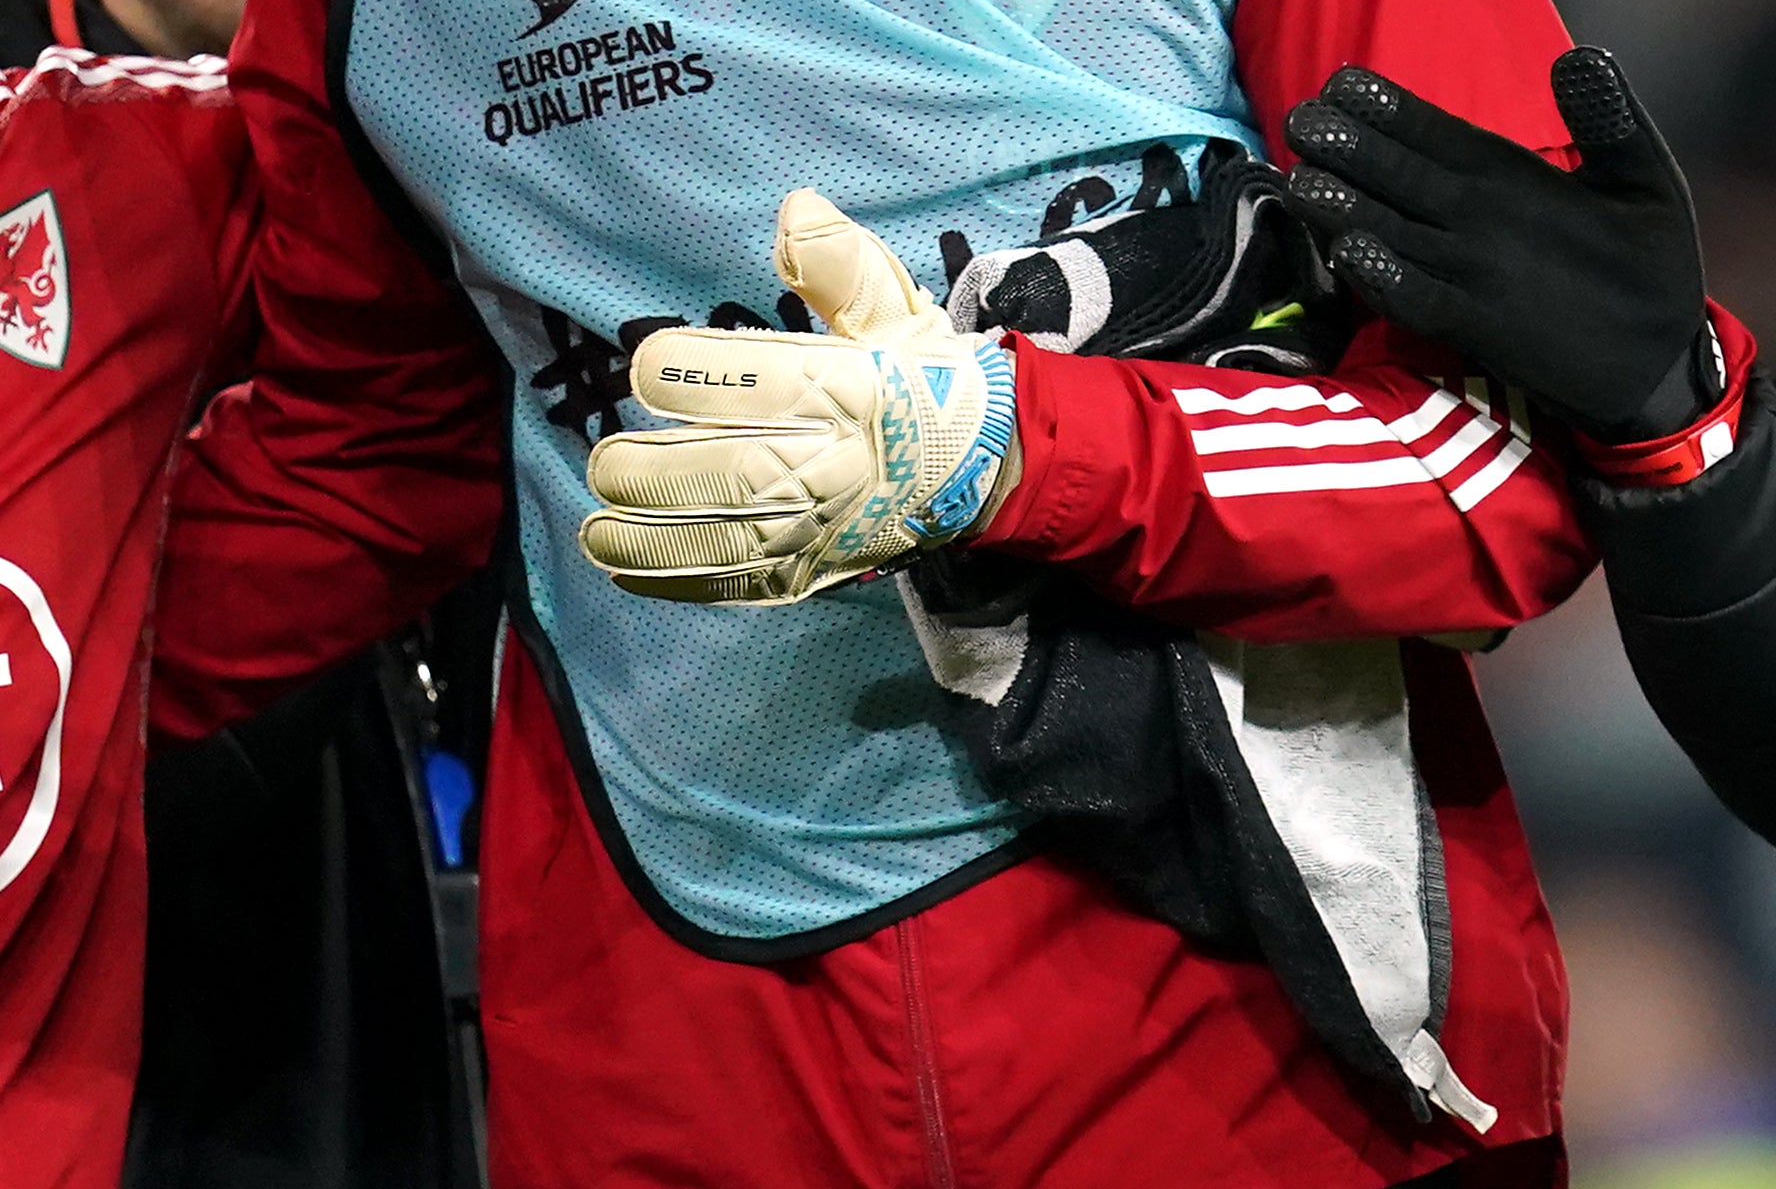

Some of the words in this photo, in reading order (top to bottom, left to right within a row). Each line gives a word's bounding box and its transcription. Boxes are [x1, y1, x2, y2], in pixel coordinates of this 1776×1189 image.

[497, 20, 677, 94] EUROPEAN
[484, 53, 714, 147] QUALIFIERS
[659, 367, 759, 388] SELLS
